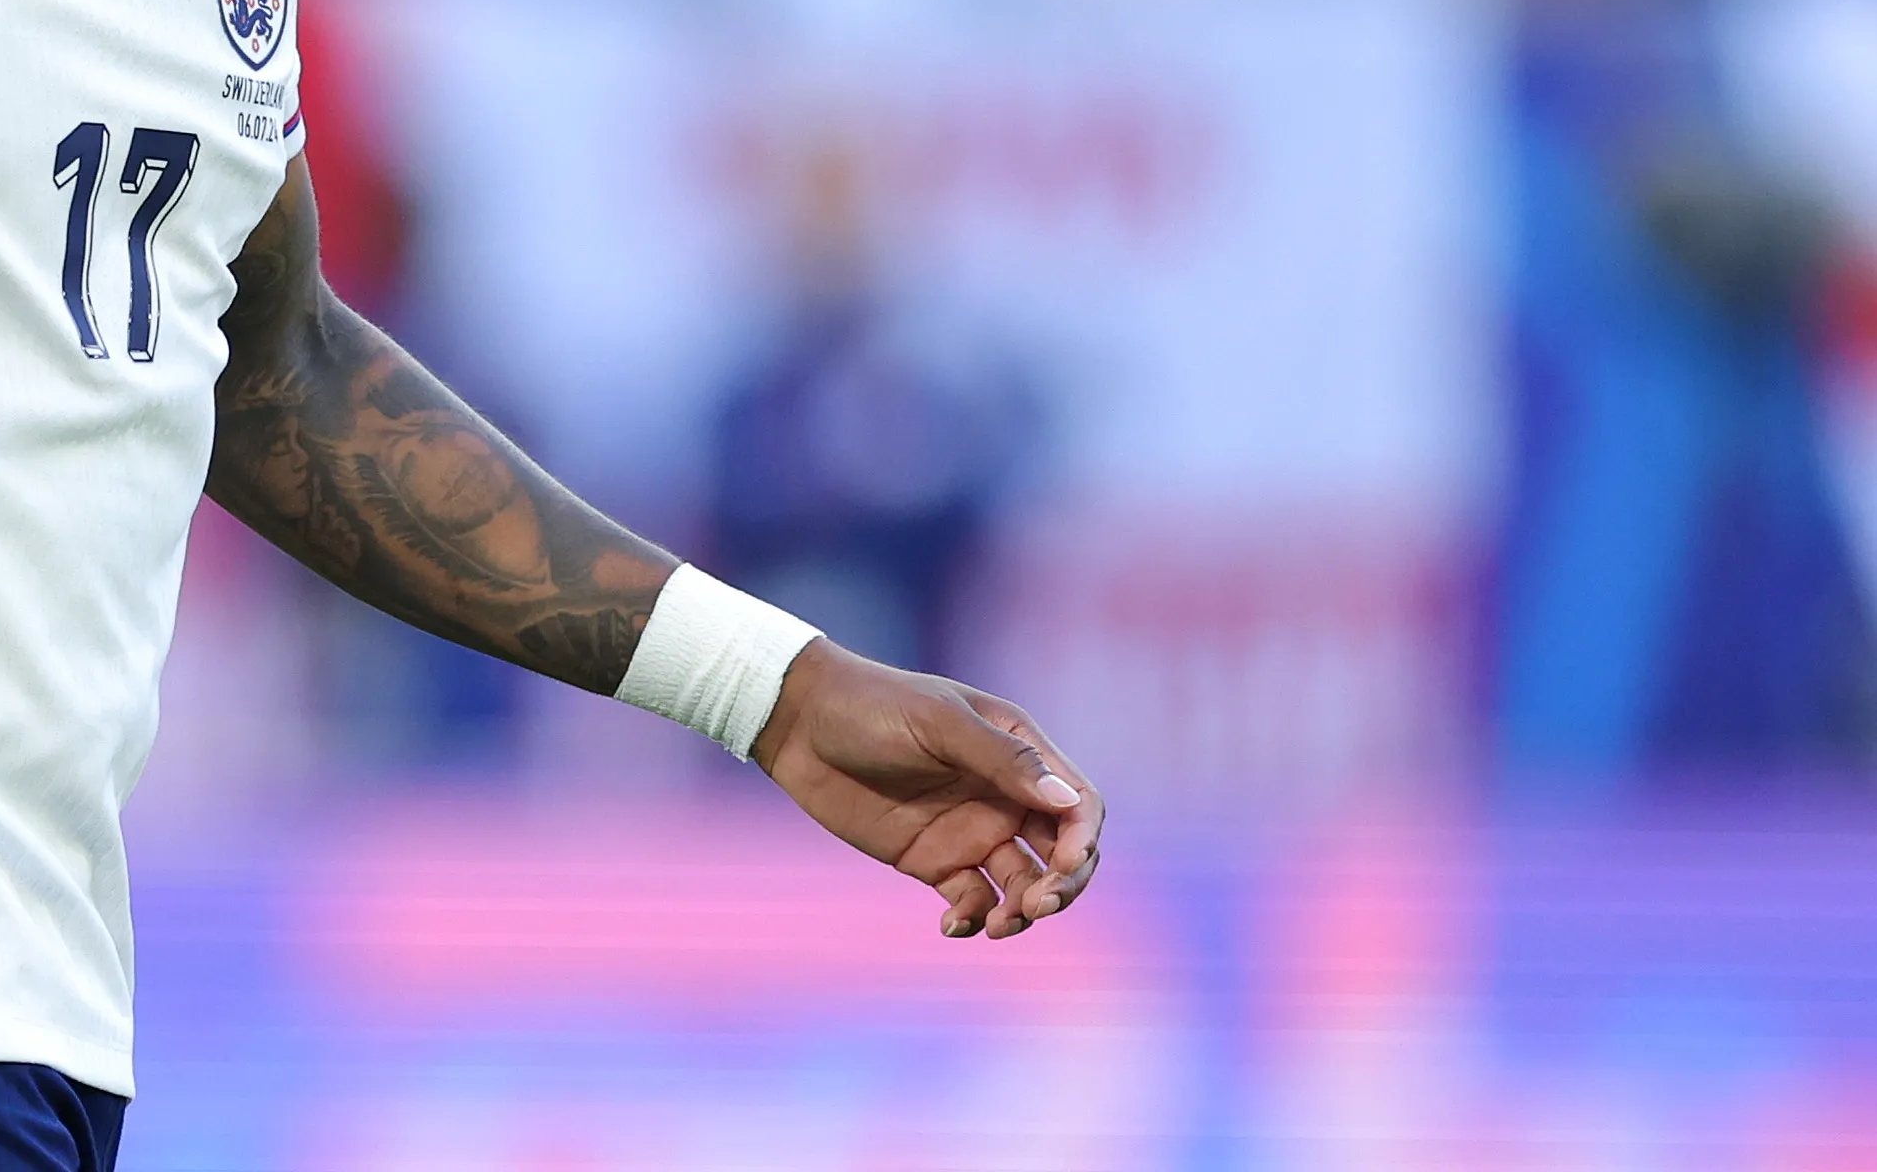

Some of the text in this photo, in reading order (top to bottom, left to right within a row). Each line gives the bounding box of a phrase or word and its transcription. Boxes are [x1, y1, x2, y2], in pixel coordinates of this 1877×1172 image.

[222, 74, 285, 110] SWITZERLAN
[238, 112, 279, 143] 06.07.24
[53, 122, 200, 362] 17
